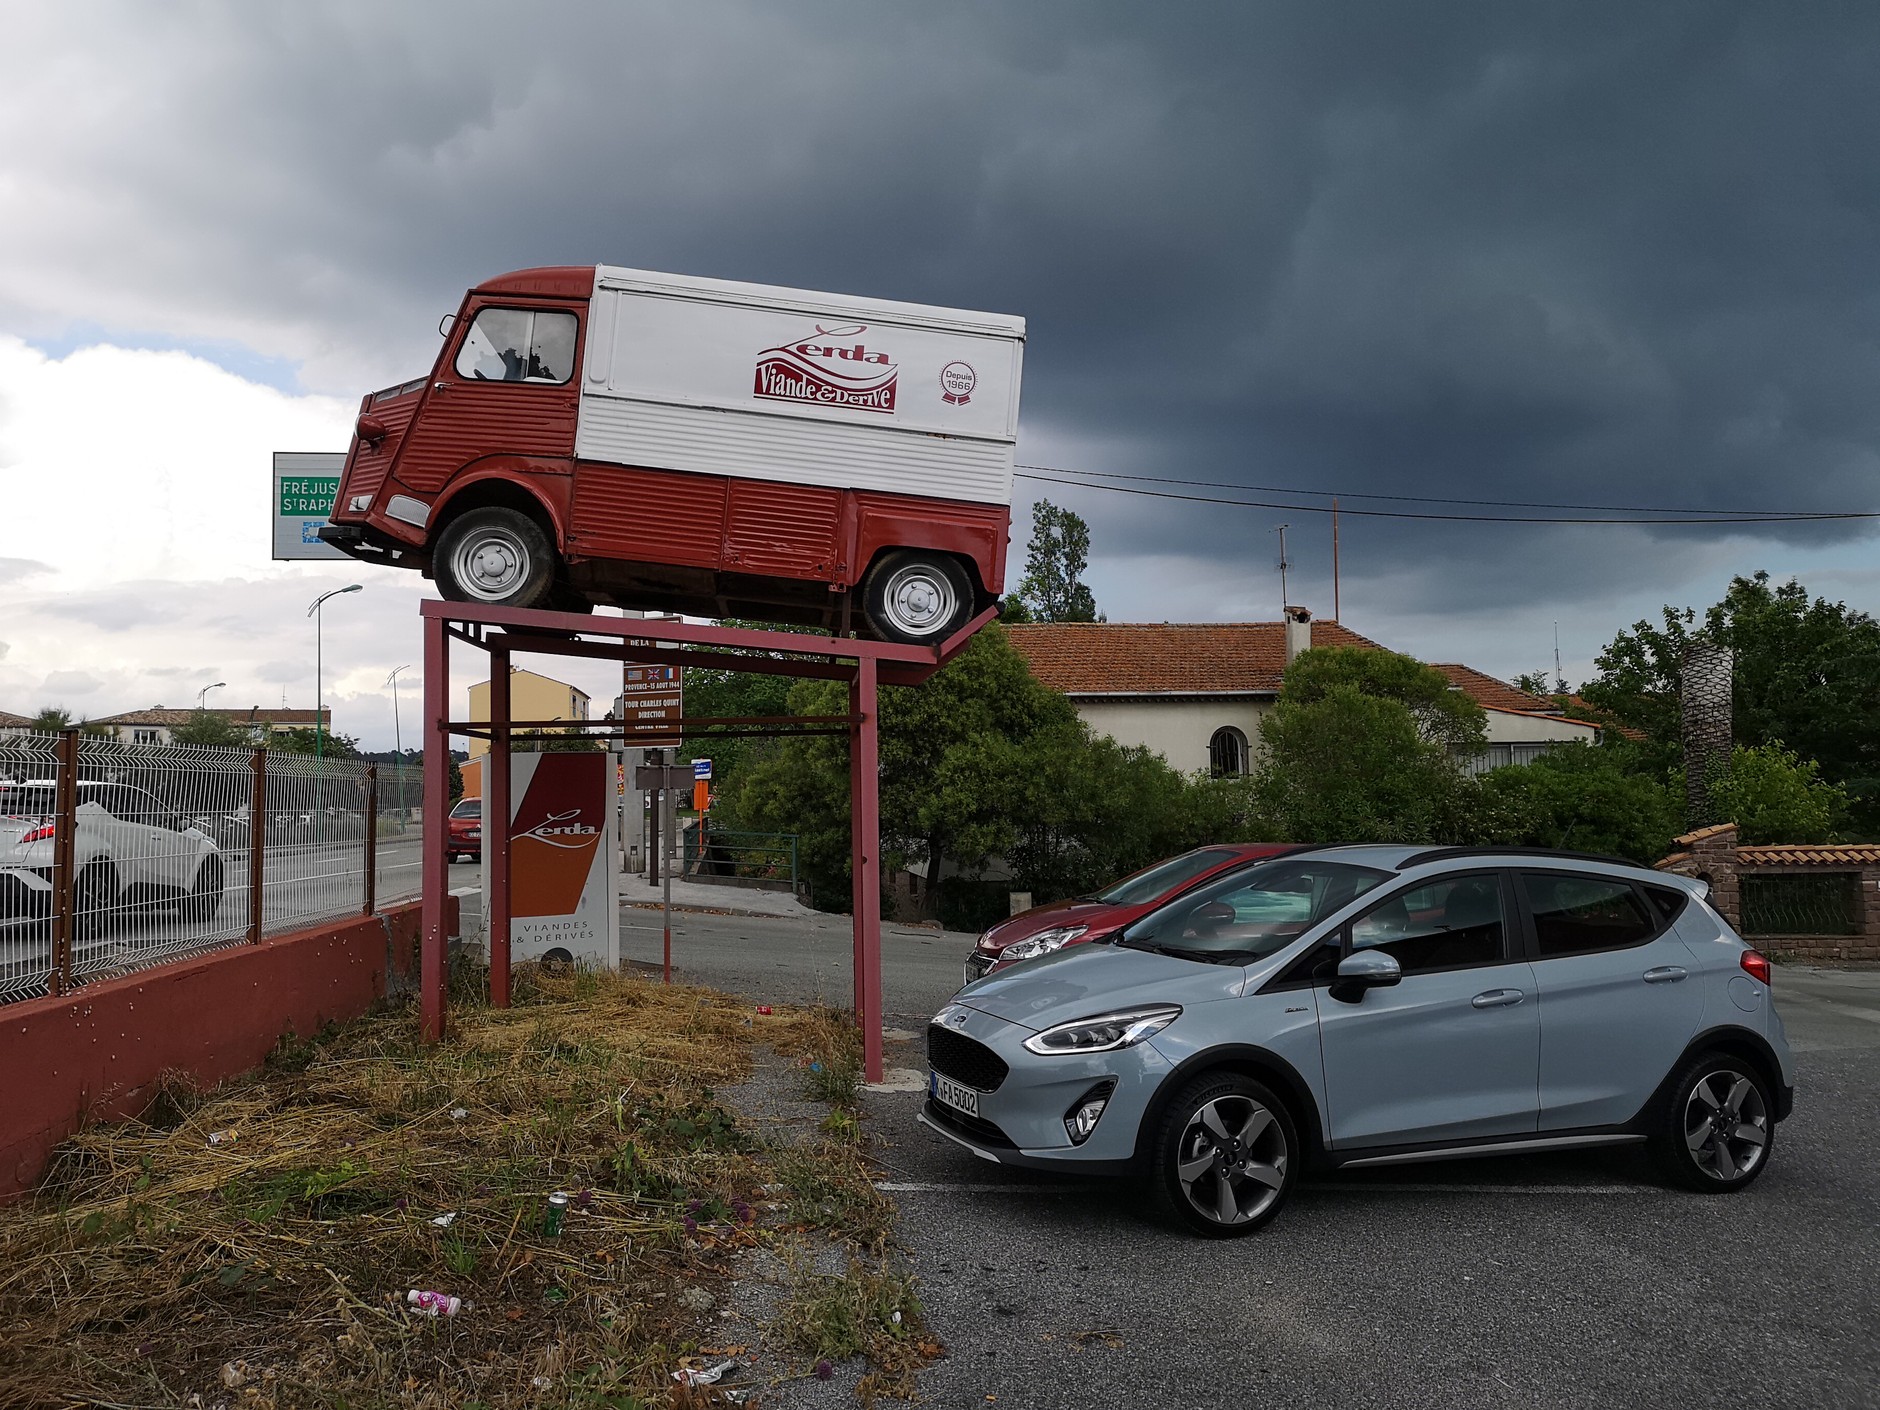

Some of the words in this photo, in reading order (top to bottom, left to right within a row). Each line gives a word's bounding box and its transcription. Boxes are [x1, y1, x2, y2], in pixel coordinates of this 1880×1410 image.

[945, 370, 973, 382] Depuis
[946, 380, 971, 391] 1966
[283, 480, 337, 494] FRÉJUS
[625, 701, 639, 709] TOUR
[639, 699, 662, 708] CHARLES
[662, 698, 680, 707] QUINT
[638, 710, 666, 719] DIRECTION
[523, 921, 588, 932] VIANDES
[516, 936, 525, 944] &
[534, 930, 594, 943] DÉRIVÉS
